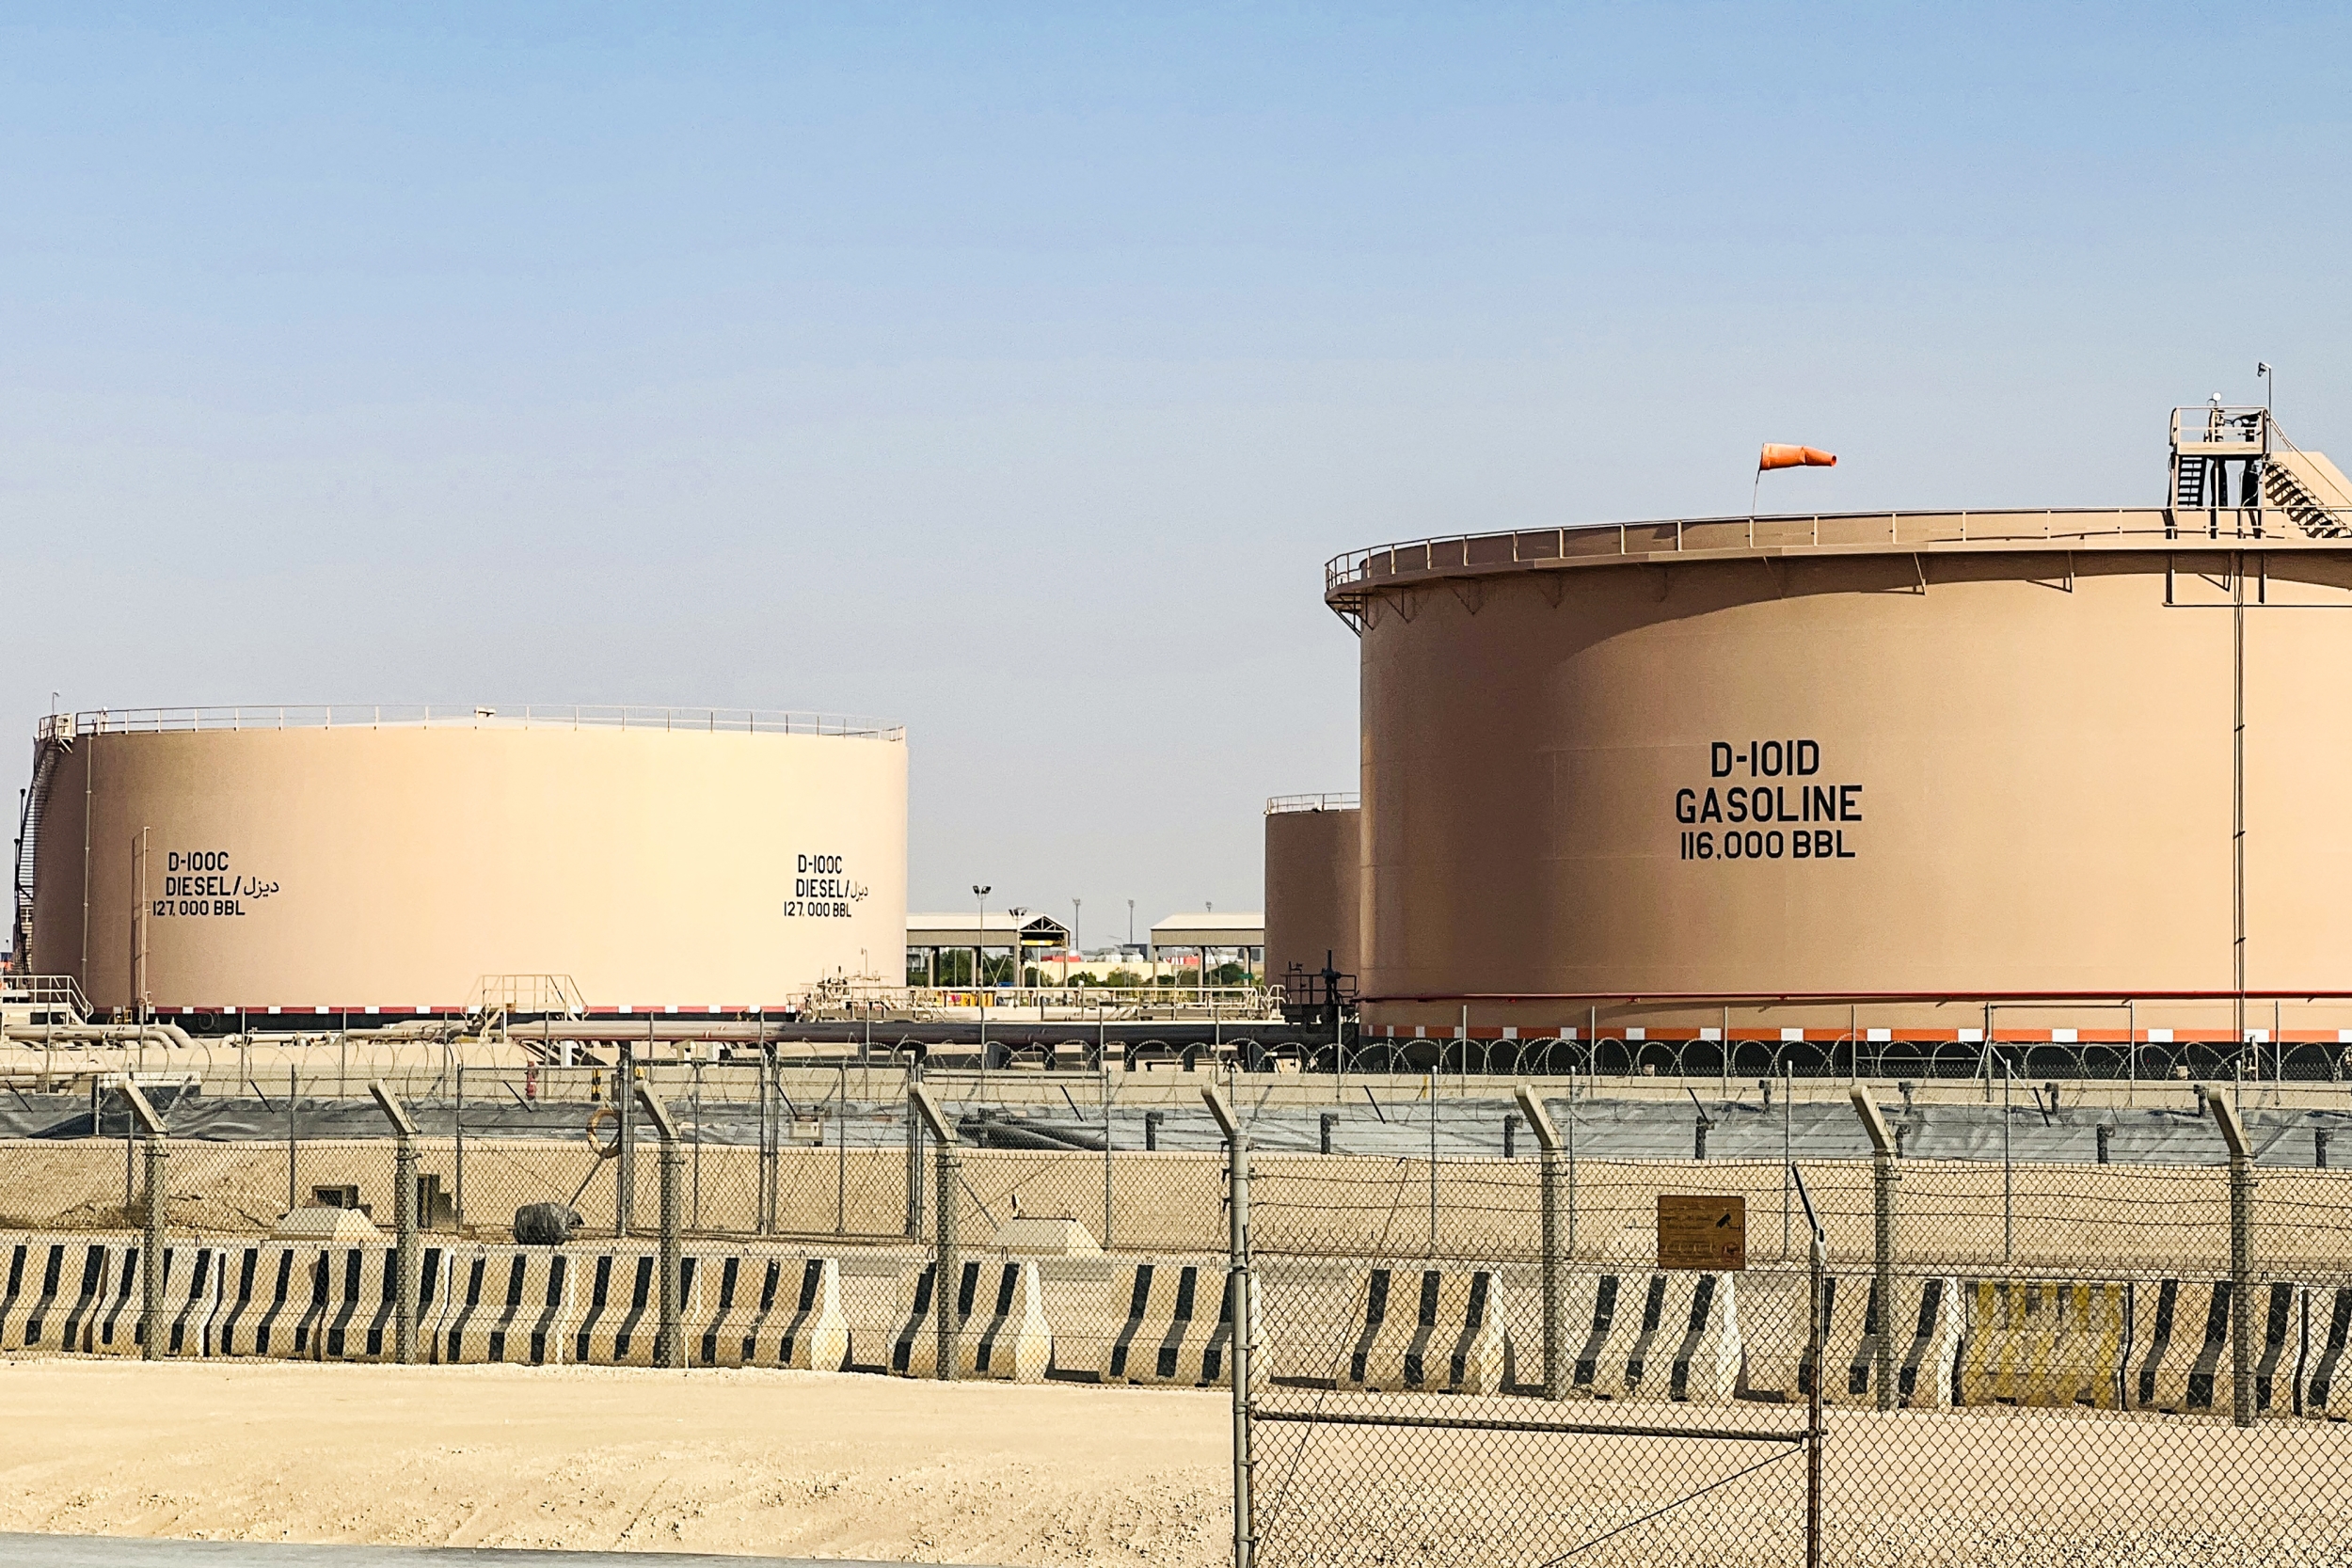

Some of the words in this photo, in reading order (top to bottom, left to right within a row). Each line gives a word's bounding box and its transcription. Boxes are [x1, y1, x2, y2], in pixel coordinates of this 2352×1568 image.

[1711, 739, 1820, 777] D-101D
[1676, 784, 1863, 824] GASOLINE
[1680, 831, 1784, 861] 116,000
[1792, 830, 1856, 859] BBL
[168, 851, 230, 872] D-100C
[798, 854, 843, 874] D-100C
[214, 899, 246, 916] BBL
[833, 902, 852, 918] BBL
